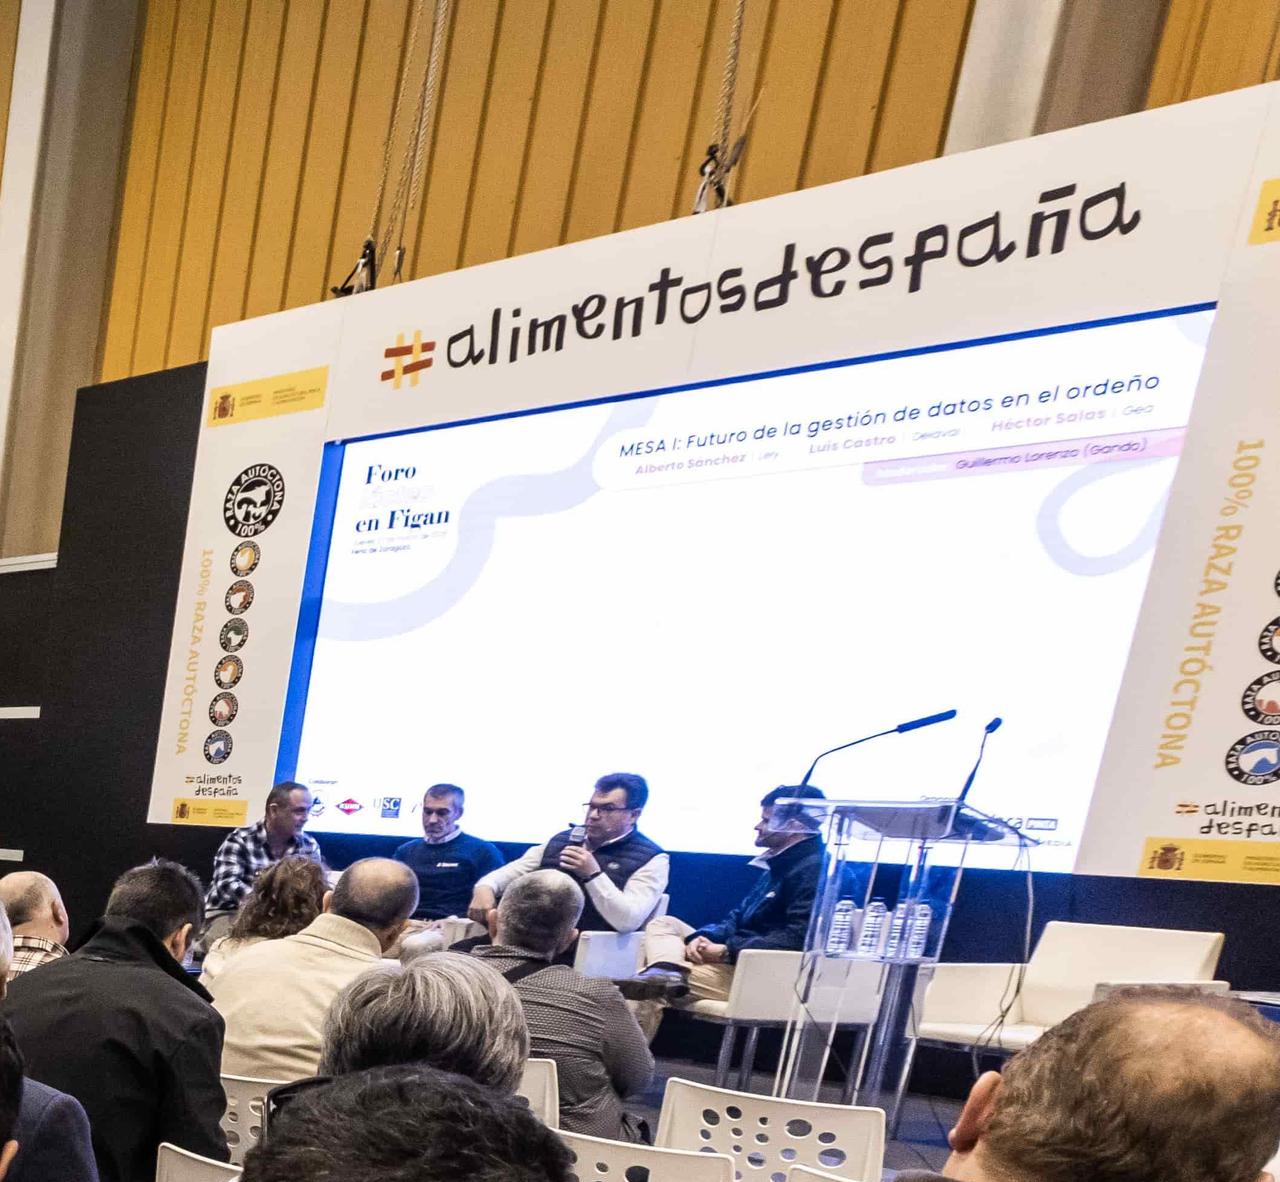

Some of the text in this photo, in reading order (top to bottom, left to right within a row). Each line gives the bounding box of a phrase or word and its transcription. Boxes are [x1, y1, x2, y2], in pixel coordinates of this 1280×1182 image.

[619, 439, 666, 458] MESA
[686, 430, 747, 449] Futuro
[753, 424, 777, 440] de
[783, 420, 801, 437] la
[806, 409, 887, 437] gestión
[893, 405, 919, 423] de
[927, 397, 993, 418] datos
[1001, 392, 1029, 407] en
[1038, 385, 1058, 402] el
[1066, 373, 1160, 400] ordeño
[1056, 408, 1105, 424] Salas
[809, 433, 896, 454] Luis Castro
[635, 460, 684, 475] Alberto
[955, 453, 1021, 471] Guillermo
[1025, 447, 1079, 463] Lorenzo
[365, 464, 416, 485] Foro
[236, 523, 265, 537] 100%
[355, 508, 450, 533] en Figan
[1200, 524, 1244, 596] RAZA
